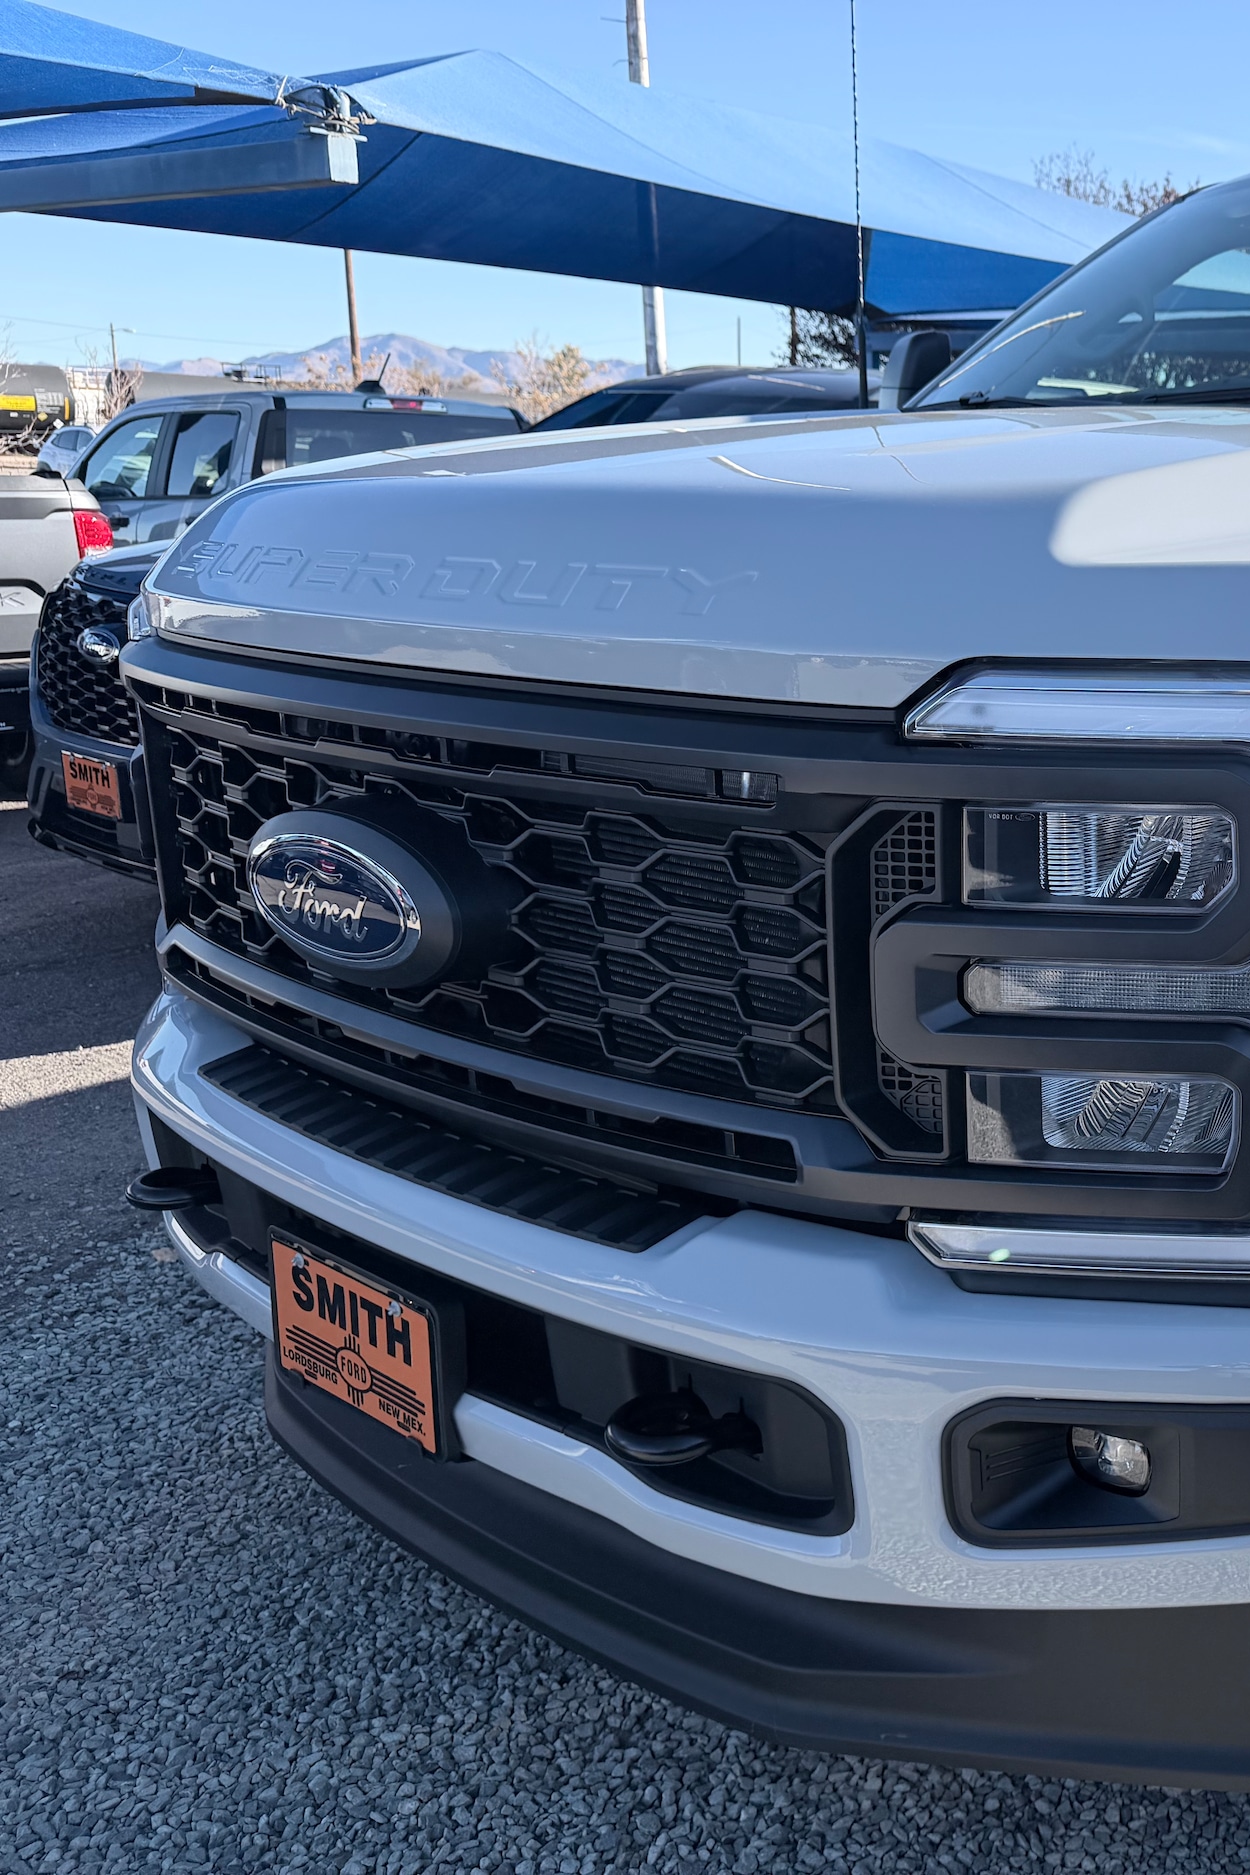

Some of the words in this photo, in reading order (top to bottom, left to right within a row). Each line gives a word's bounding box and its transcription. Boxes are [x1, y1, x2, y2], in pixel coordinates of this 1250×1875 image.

[172, 540, 416, 598] SUPER
[418, 555, 760, 616] DUTY
[69, 761, 111, 788] SMITH
[278, 859, 369, 943] Ford
[291, 1258, 412, 1367] SMITH
[283, 1346, 338, 1385] LORDSBURG
[340, 1355, 368, 1384] FORD
[378, 1398, 400, 1420] NEW
[402, 1415, 426, 1436] MEX.
